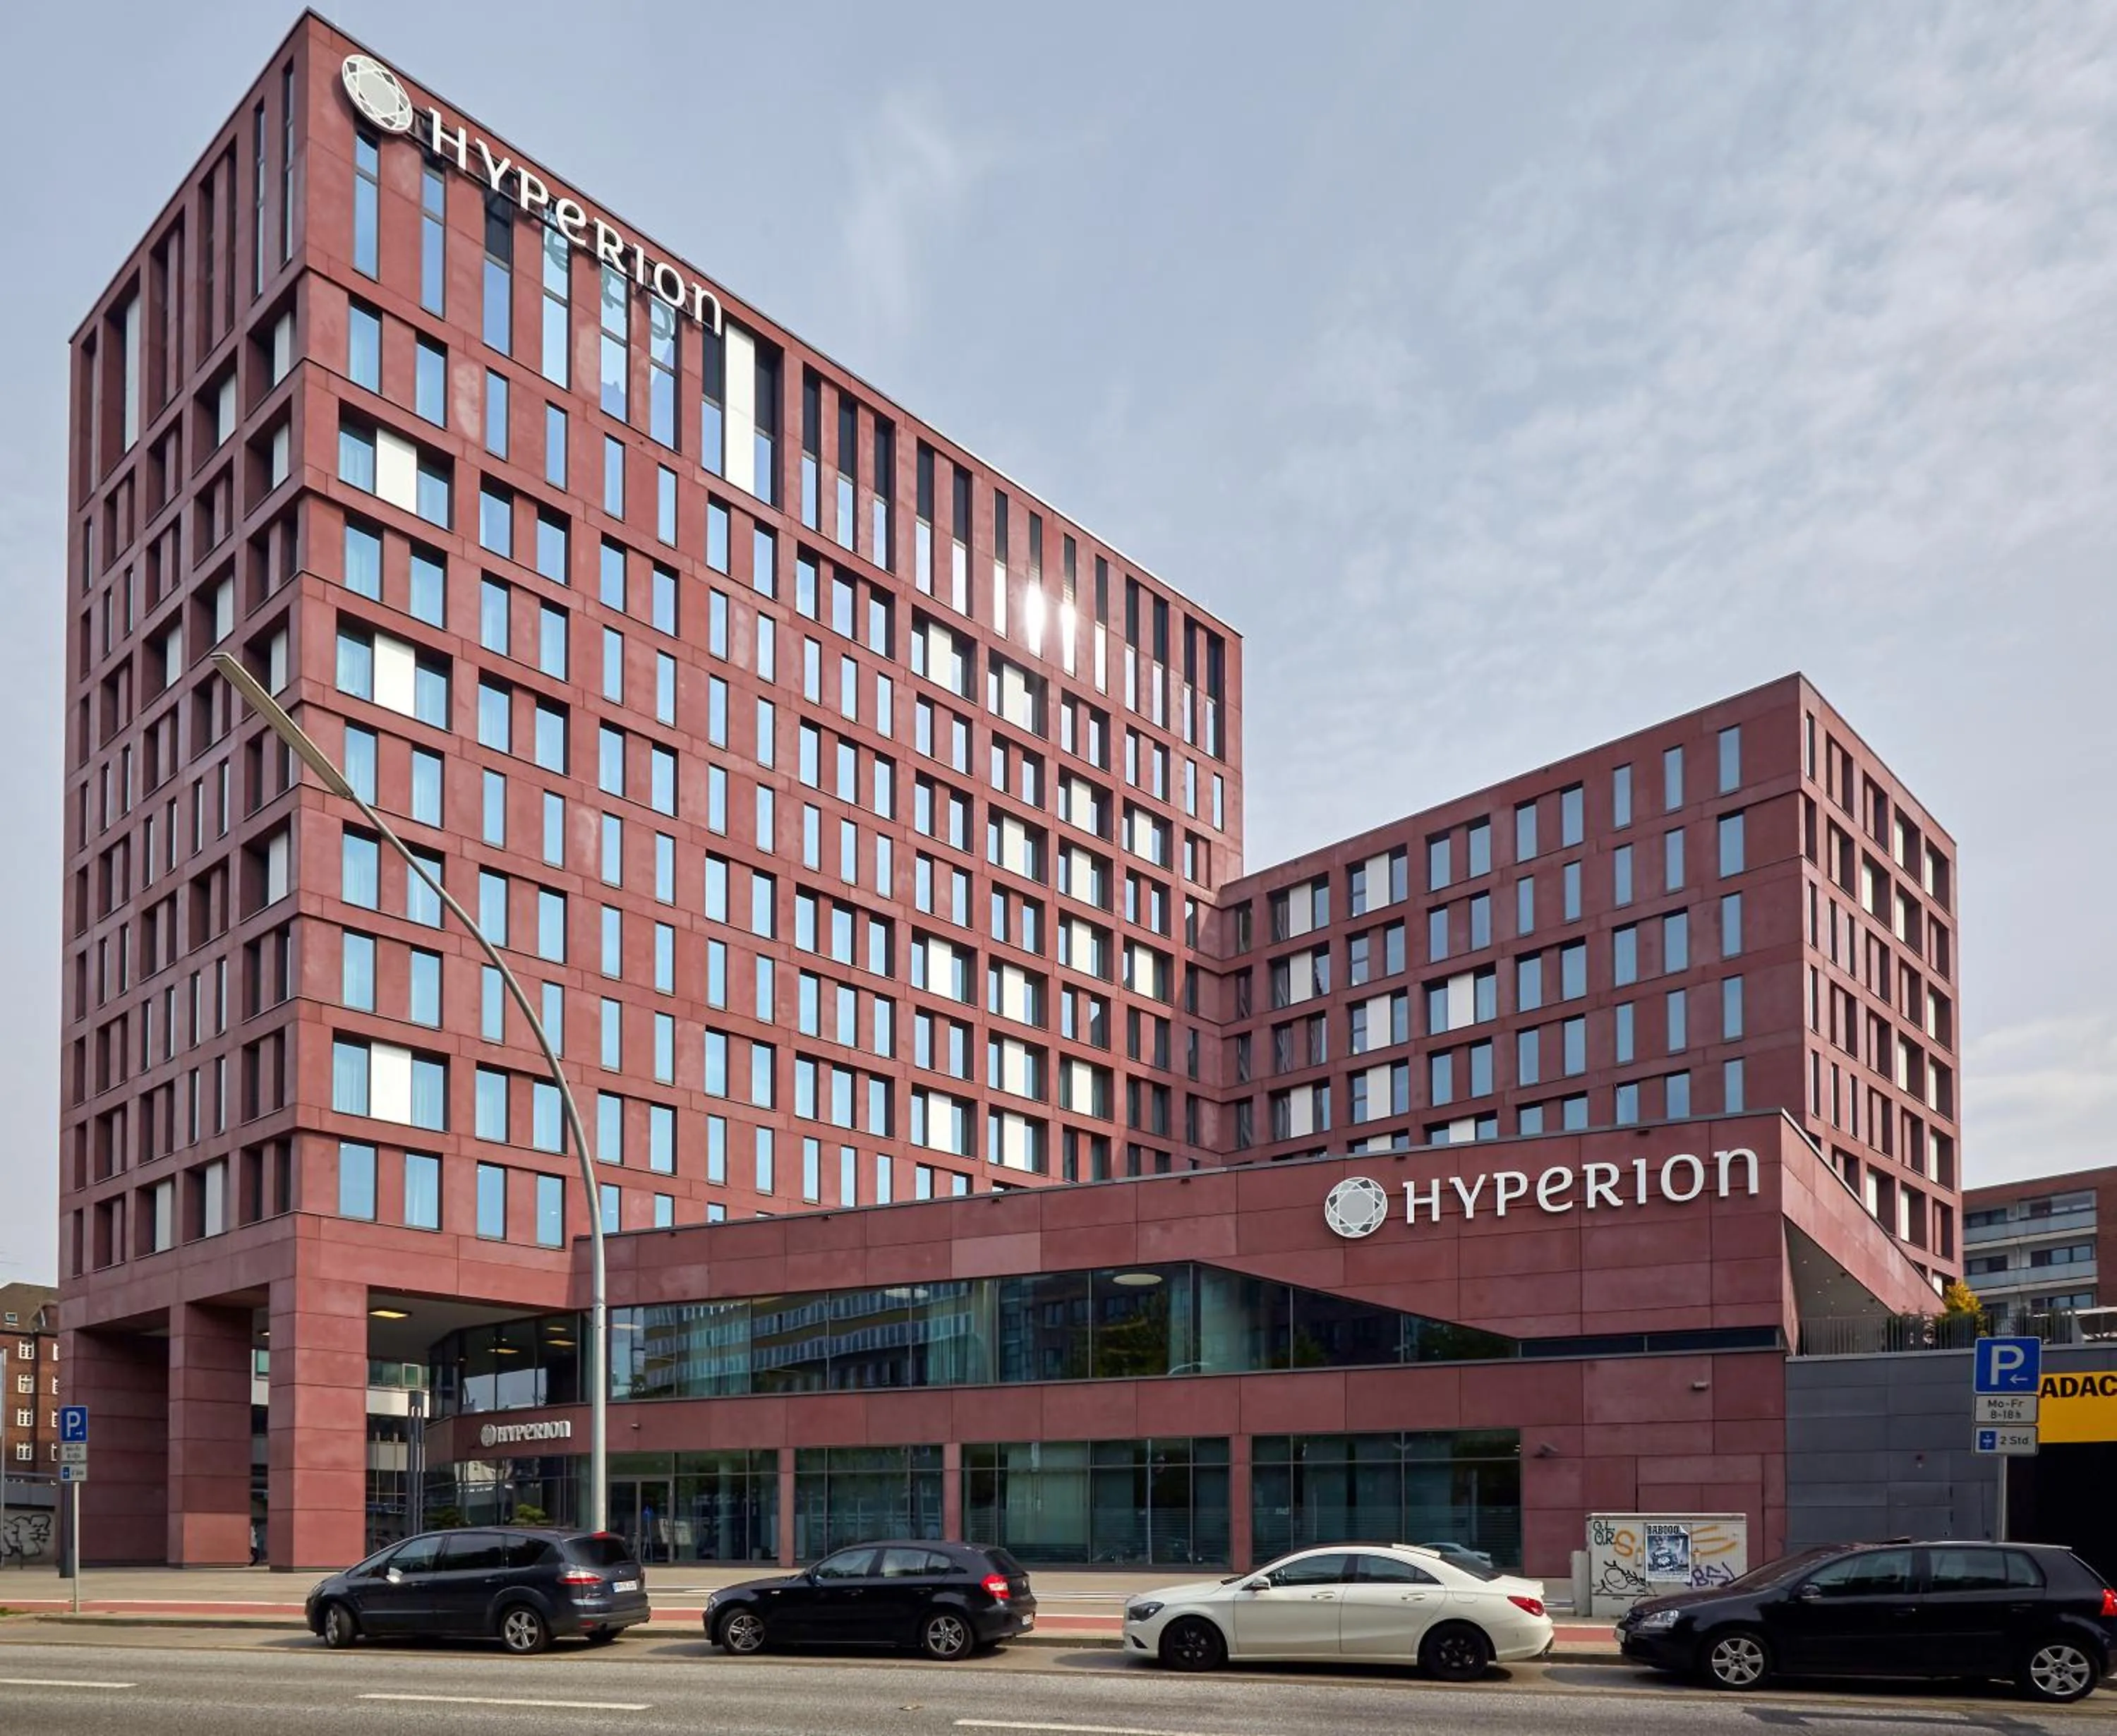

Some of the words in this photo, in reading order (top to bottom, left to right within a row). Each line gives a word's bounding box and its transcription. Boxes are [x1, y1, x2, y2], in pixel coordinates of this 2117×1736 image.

[1990, 1344, 2025, 1385] P
[2041, 1374, 2117, 1398] ADAC
[1987, 1399, 2025, 1408] Mo-Fr
[66, 1411, 81, 1437] P
